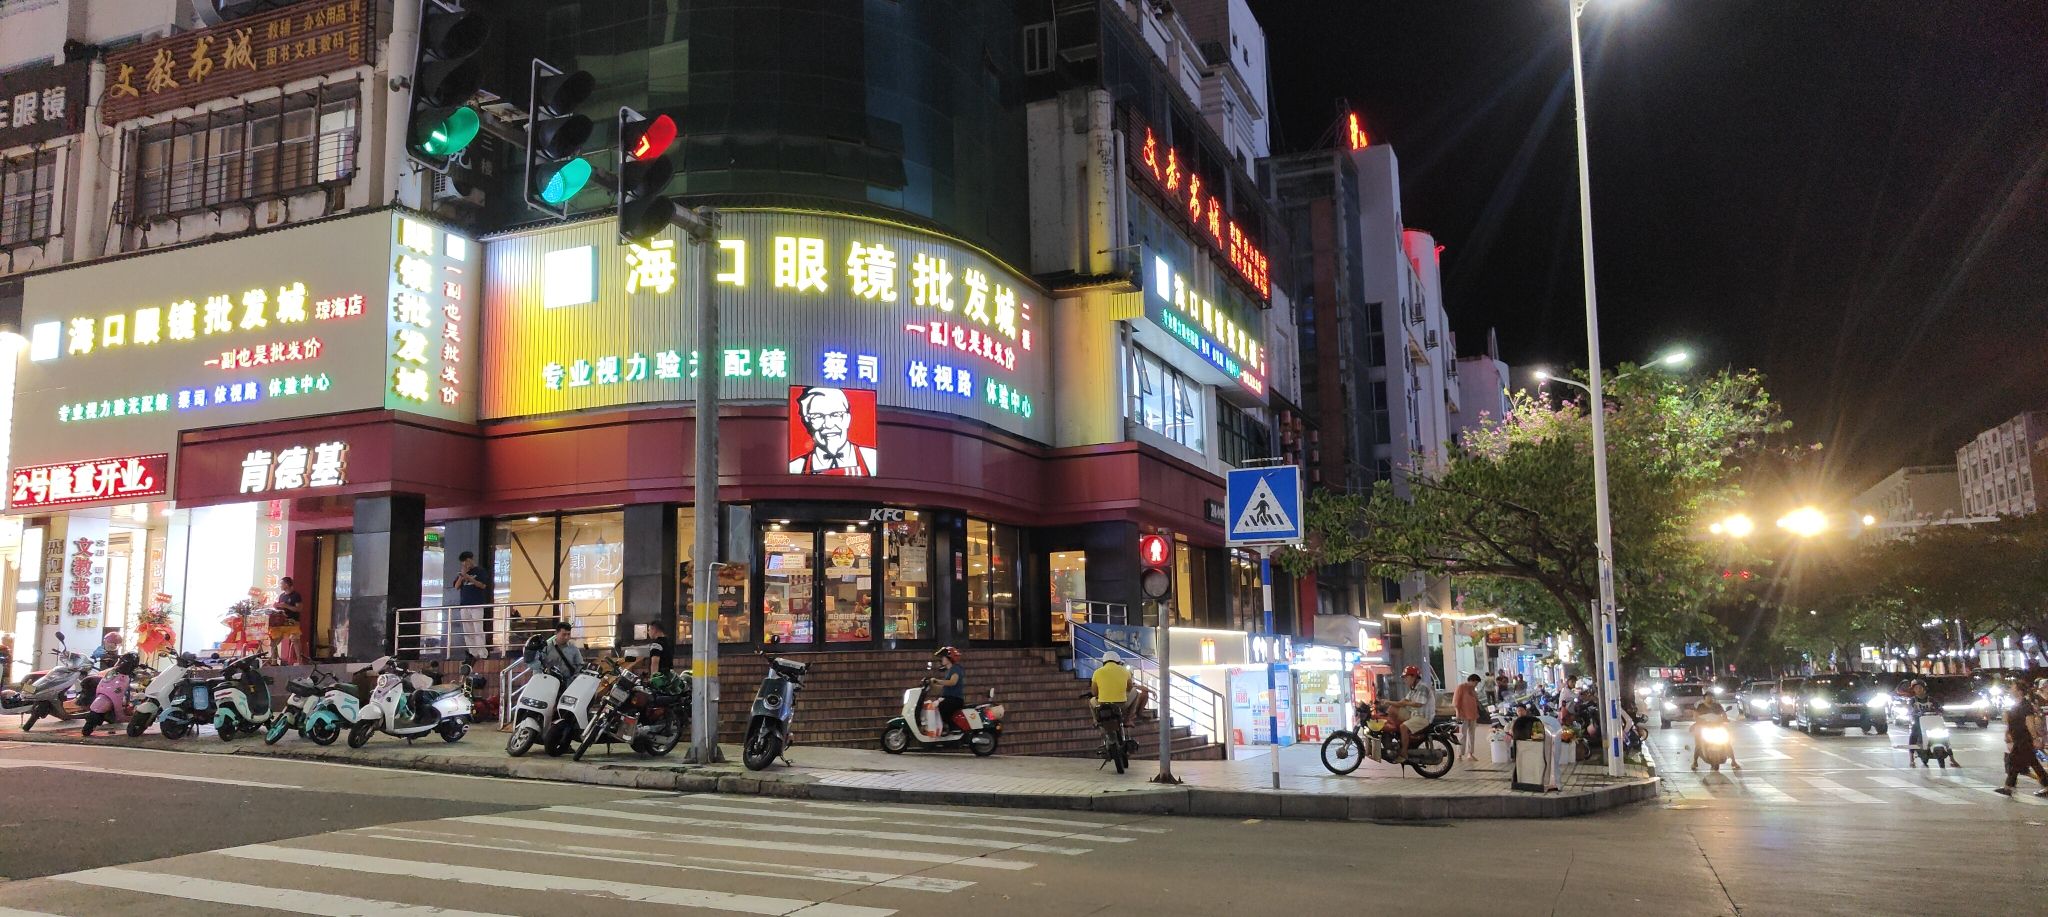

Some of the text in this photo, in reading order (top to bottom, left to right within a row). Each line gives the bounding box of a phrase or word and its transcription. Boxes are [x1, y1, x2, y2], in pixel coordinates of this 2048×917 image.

[303, 3, 347, 31] 办公用品
[110, 26, 258, 98] 文教书城
[67, 281, 367, 356] 海口眼镜批发城 琼海店
[625, 236, 1018, 342] 海口眼镜批发城
[203, 336, 323, 371] 一副也是批发价
[441, 265, 462, 405] 一副也是批发价
[905, 320, 1018, 371] 一副也是批发价
[57, 372, 332, 424] 专业视力验光配镜 蔡司 依视路 体验中心
[823, 350, 879, 384] 蔡司
[908, 359, 975, 398] 依视路
[984, 377, 1033, 420] 体验中心
[239, 441, 349, 494] 肯德基
[869, 508, 904, 521] KFC
[68, 537, 94, 616] 文教书城
